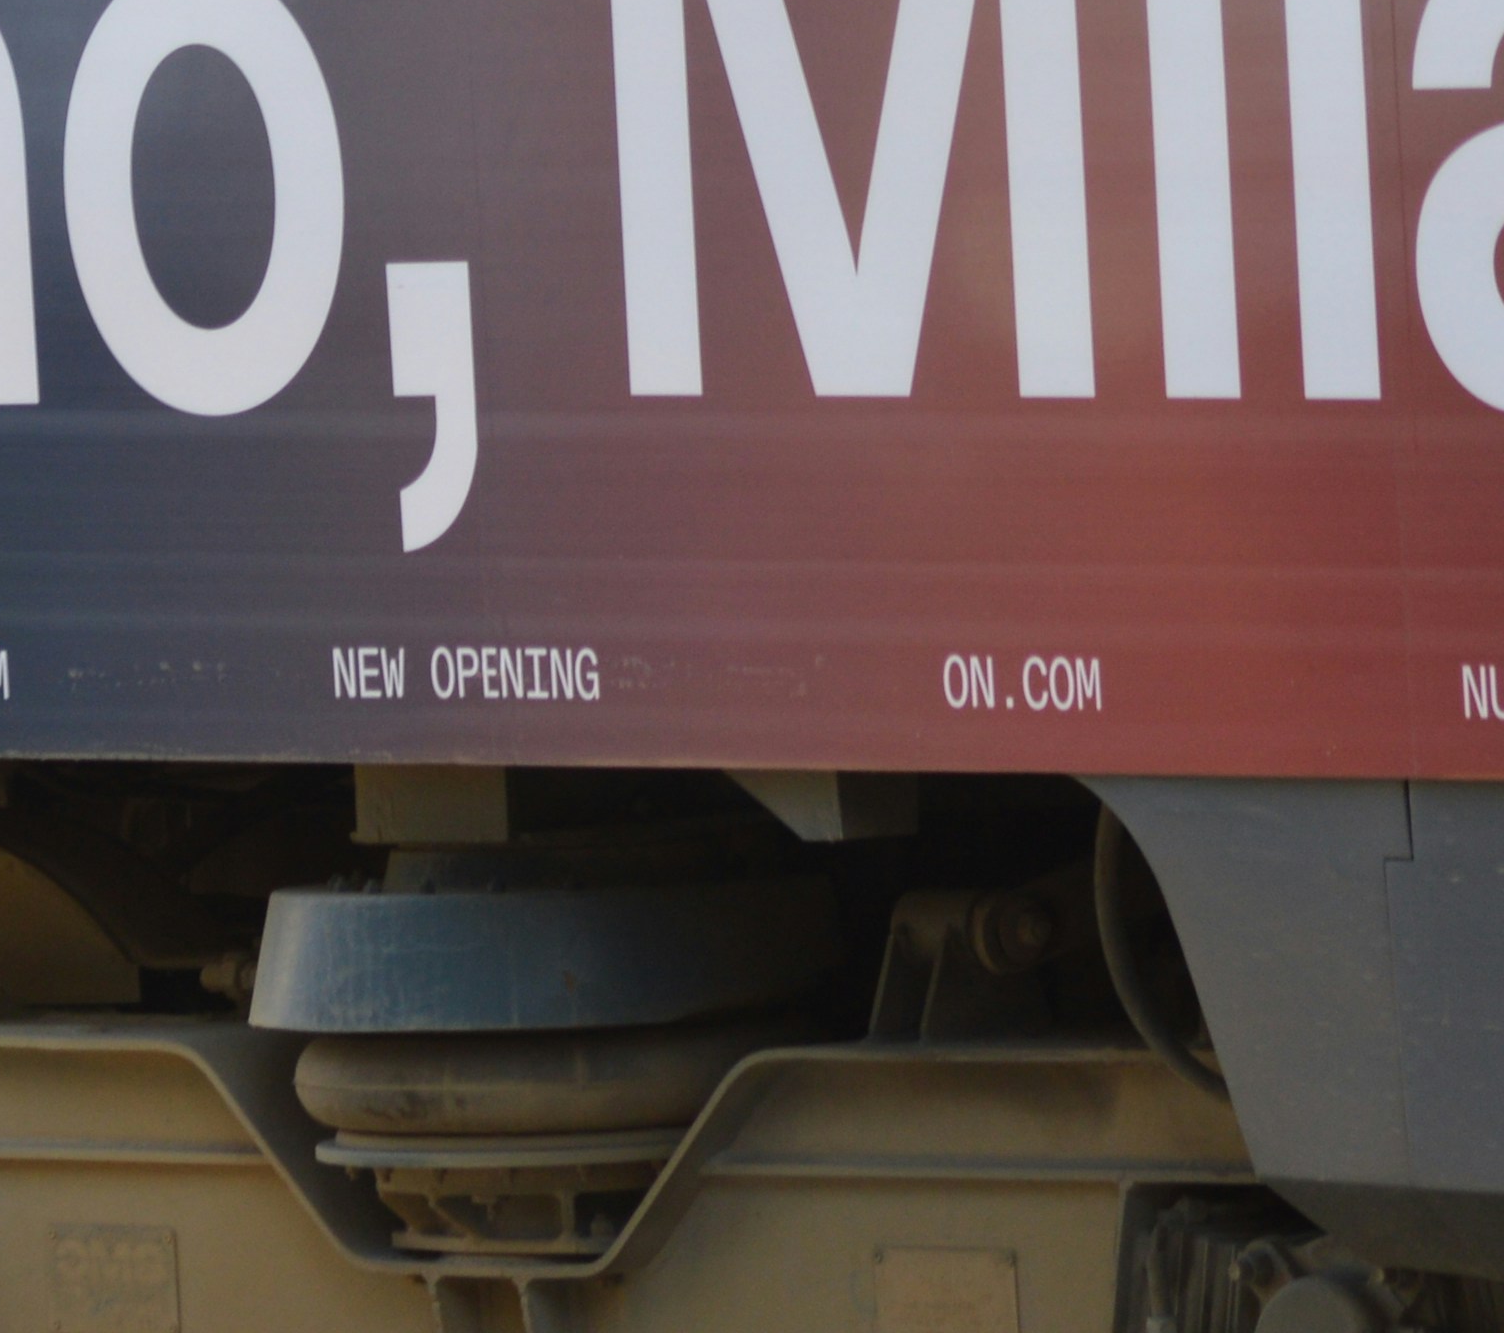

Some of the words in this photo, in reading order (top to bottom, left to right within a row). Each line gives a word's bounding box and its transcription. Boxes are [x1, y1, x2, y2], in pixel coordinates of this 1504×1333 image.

[332, 647, 405, 699] NEW
[430, 646, 601, 701] OPENING
[943, 654, 1103, 712] ON.COM
